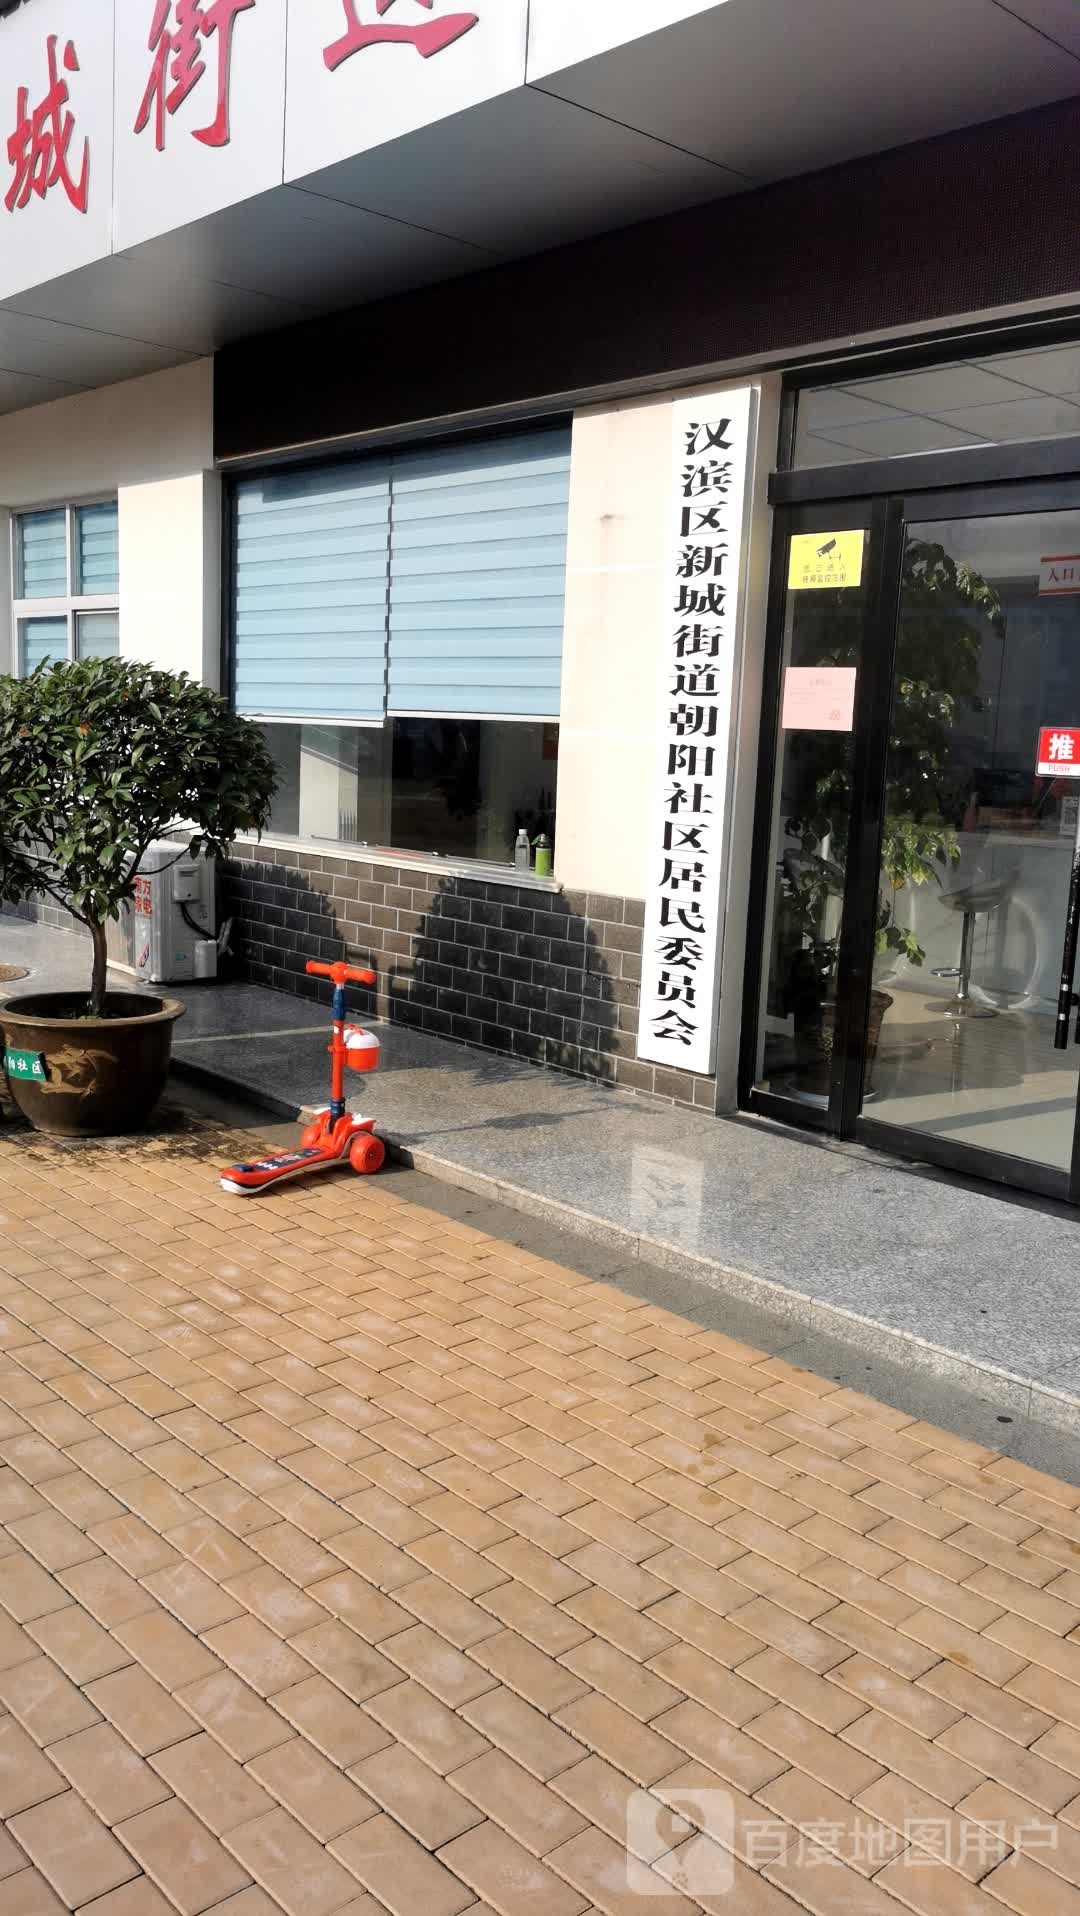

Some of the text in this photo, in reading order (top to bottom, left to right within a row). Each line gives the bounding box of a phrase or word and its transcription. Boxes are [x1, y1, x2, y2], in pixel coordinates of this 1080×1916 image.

[649, 418, 735, 1046] 汉滨区新城街道朝阳社区居民委员会
[1048, 733, 1075, 760] 推
